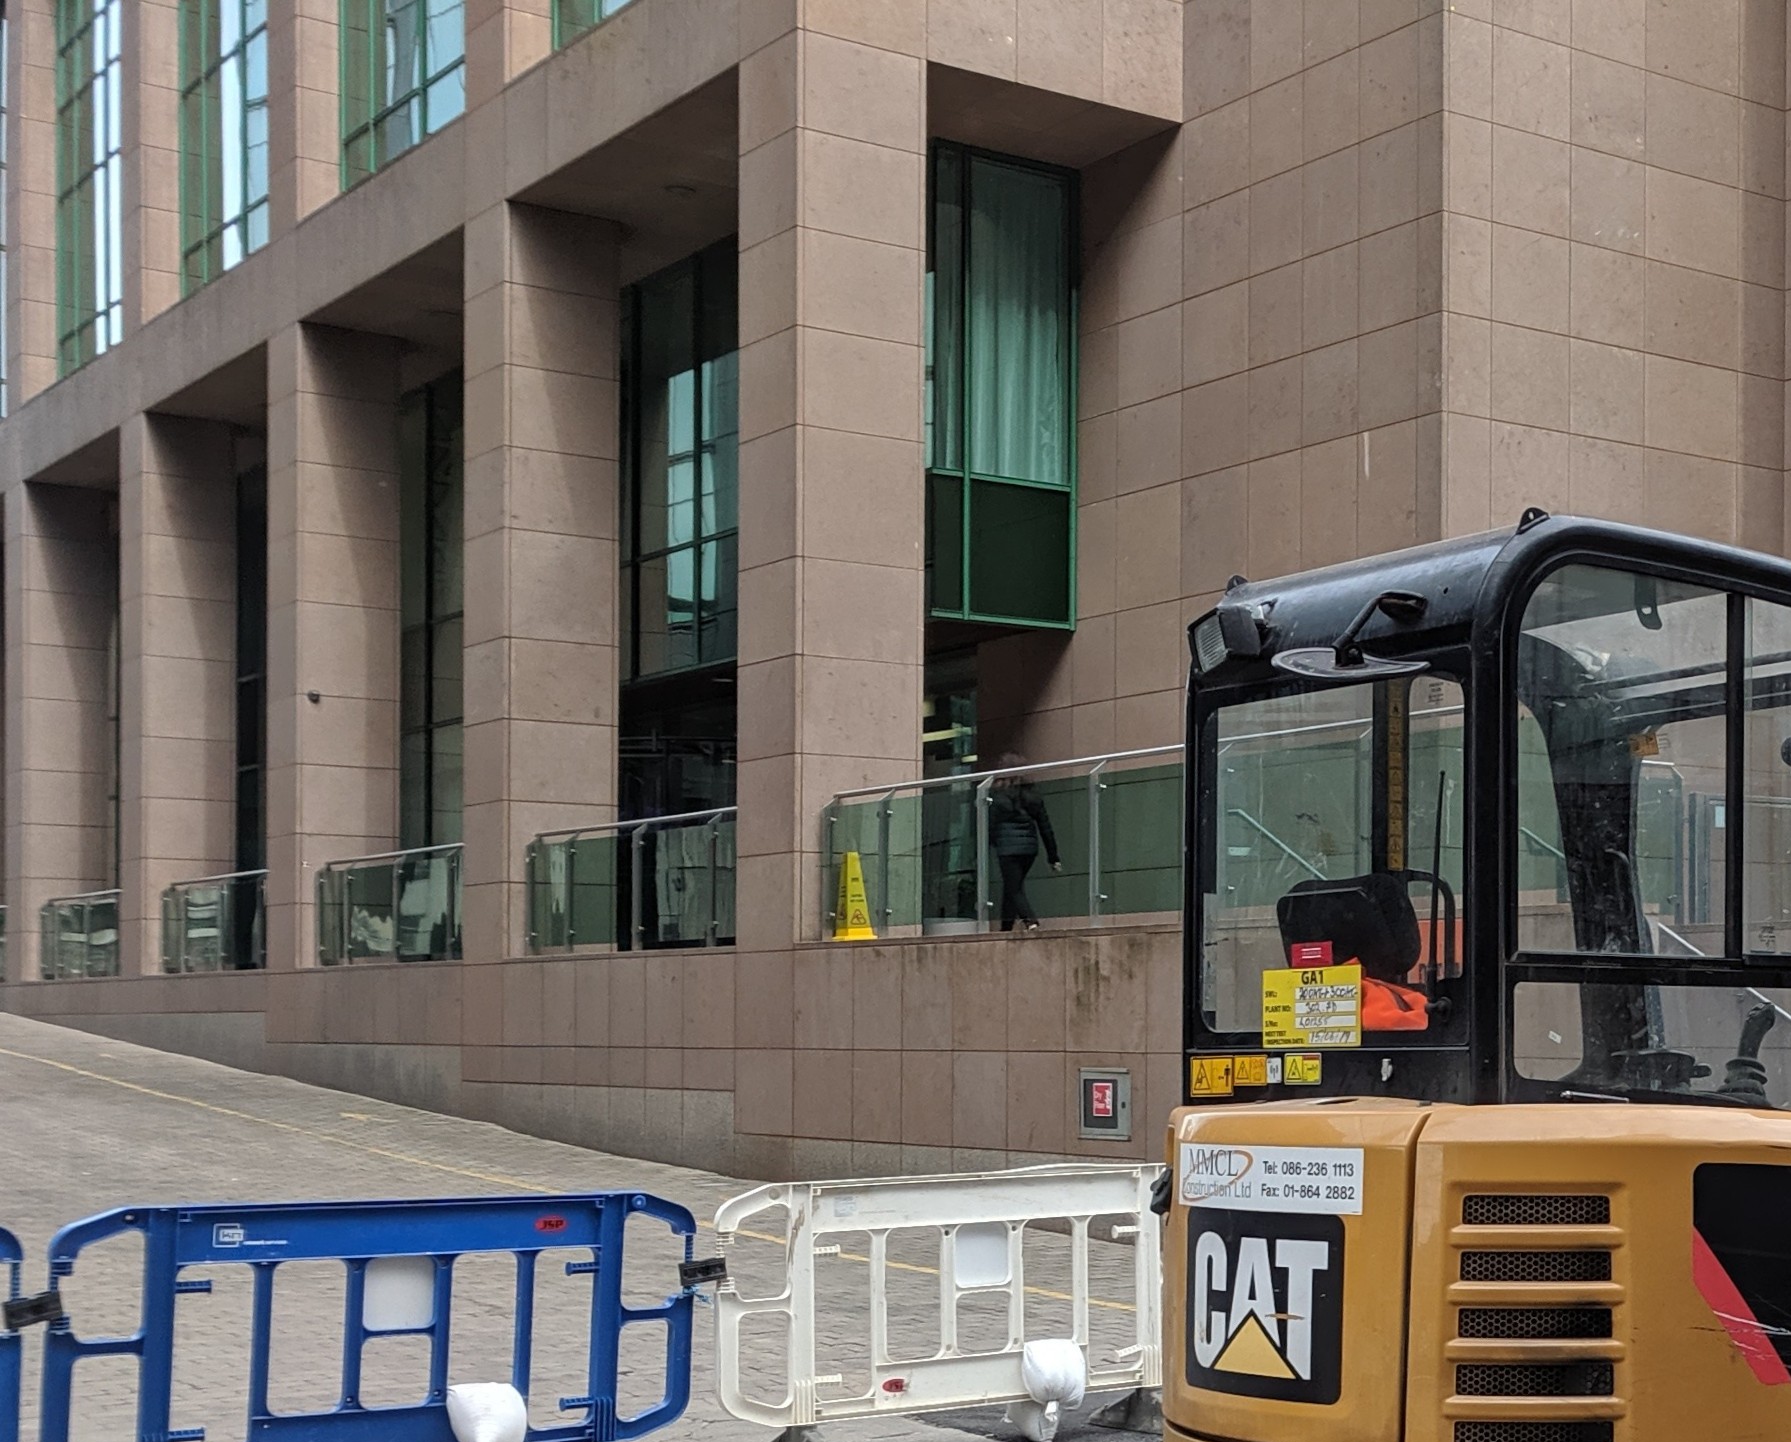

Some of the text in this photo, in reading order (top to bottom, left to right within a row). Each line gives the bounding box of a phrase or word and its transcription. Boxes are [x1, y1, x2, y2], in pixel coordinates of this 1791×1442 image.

[1301, 970, 1324, 985] GA1
[1189, 1148, 1239, 1177] MMCL
[1263, 1160, 1354, 1177] Tel: 086-236 1113
[1234, 1178, 1252, 1198] Ltd
[1261, 1183, 1355, 1200] Fax: 01-864 2882
[1194, 1230, 1329, 1381] CAT
